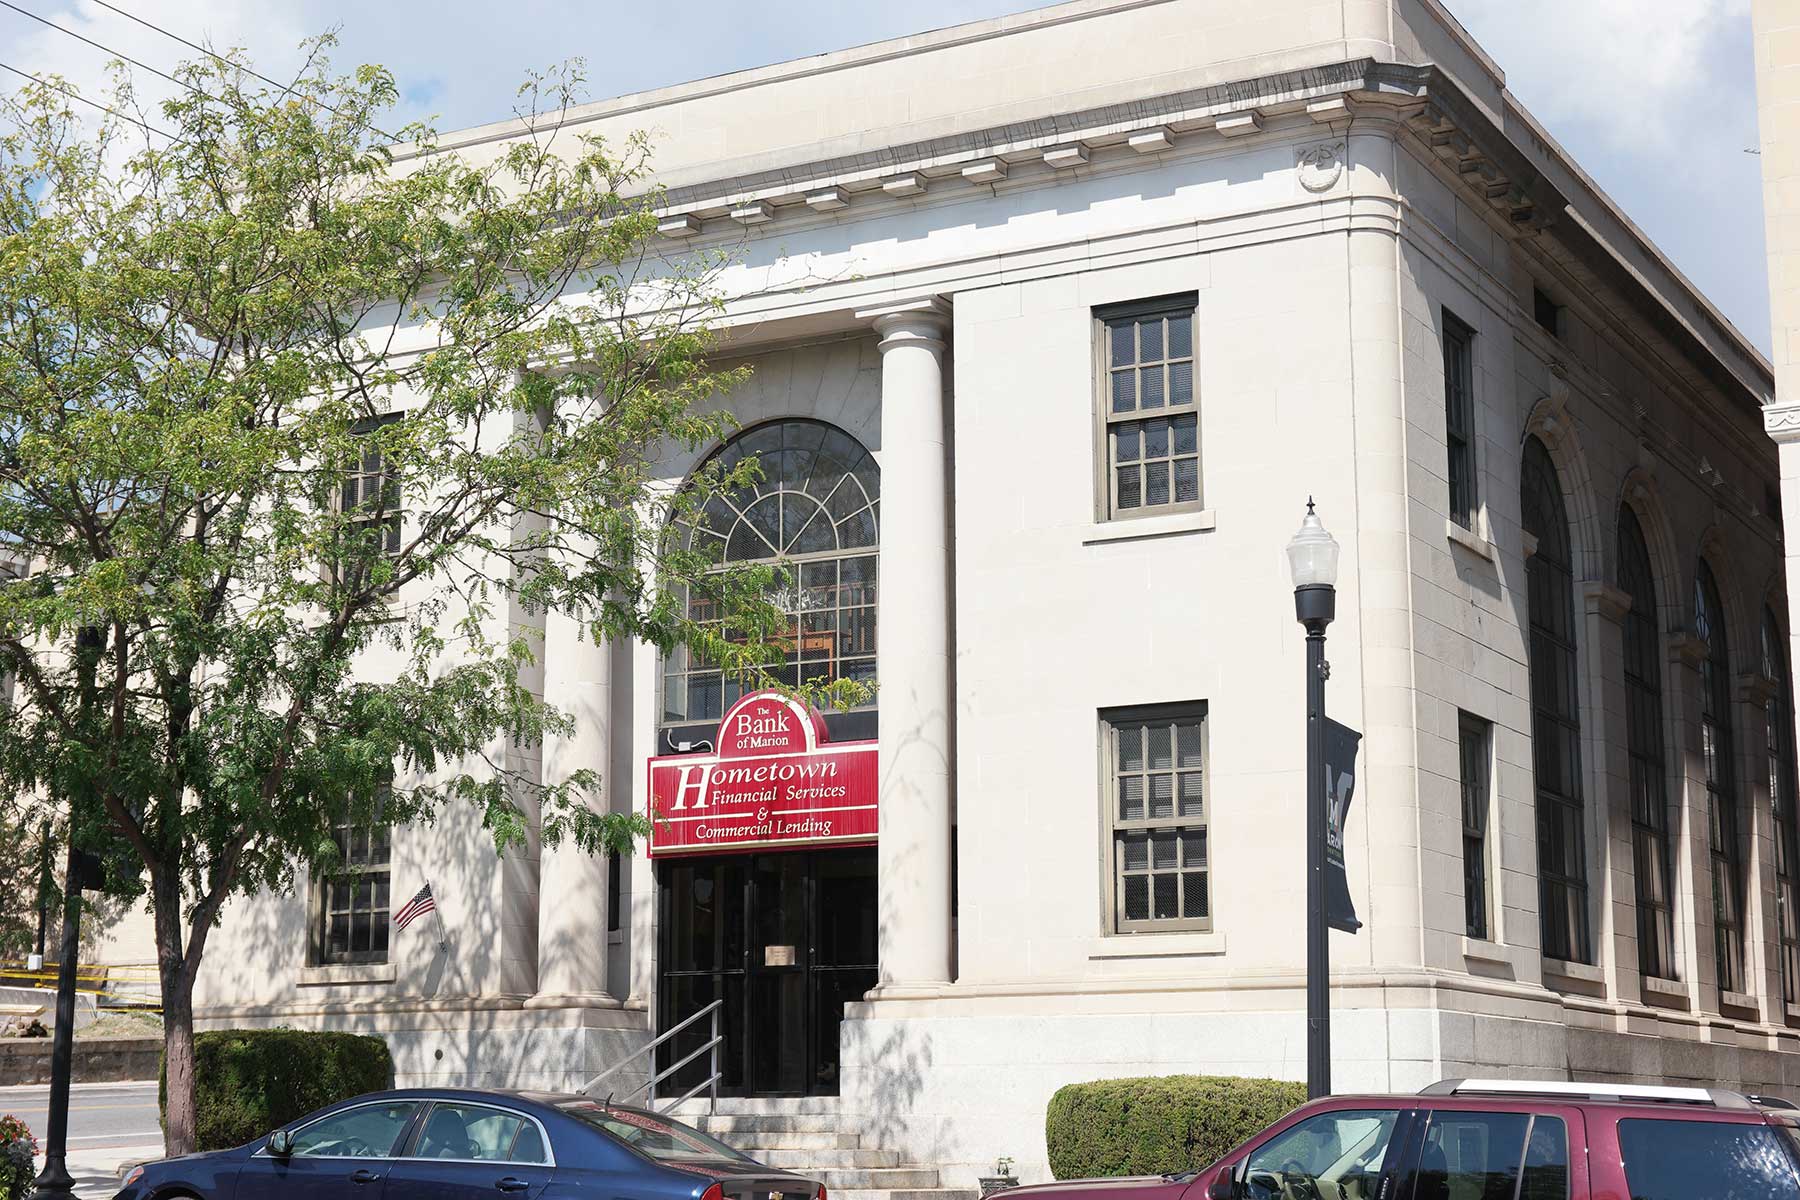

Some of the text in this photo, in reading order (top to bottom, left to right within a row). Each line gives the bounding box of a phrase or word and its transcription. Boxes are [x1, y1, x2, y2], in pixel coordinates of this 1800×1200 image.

[757, 707, 770, 715] The
[736, 711, 790, 736] Bank
[737, 736, 789, 750] of Marion
[671, 762, 837, 811] Hometown
[711, 785, 846, 806] Financial Services
[757, 807, 769, 821] &
[696, 818, 832, 840] Commercial Lending
